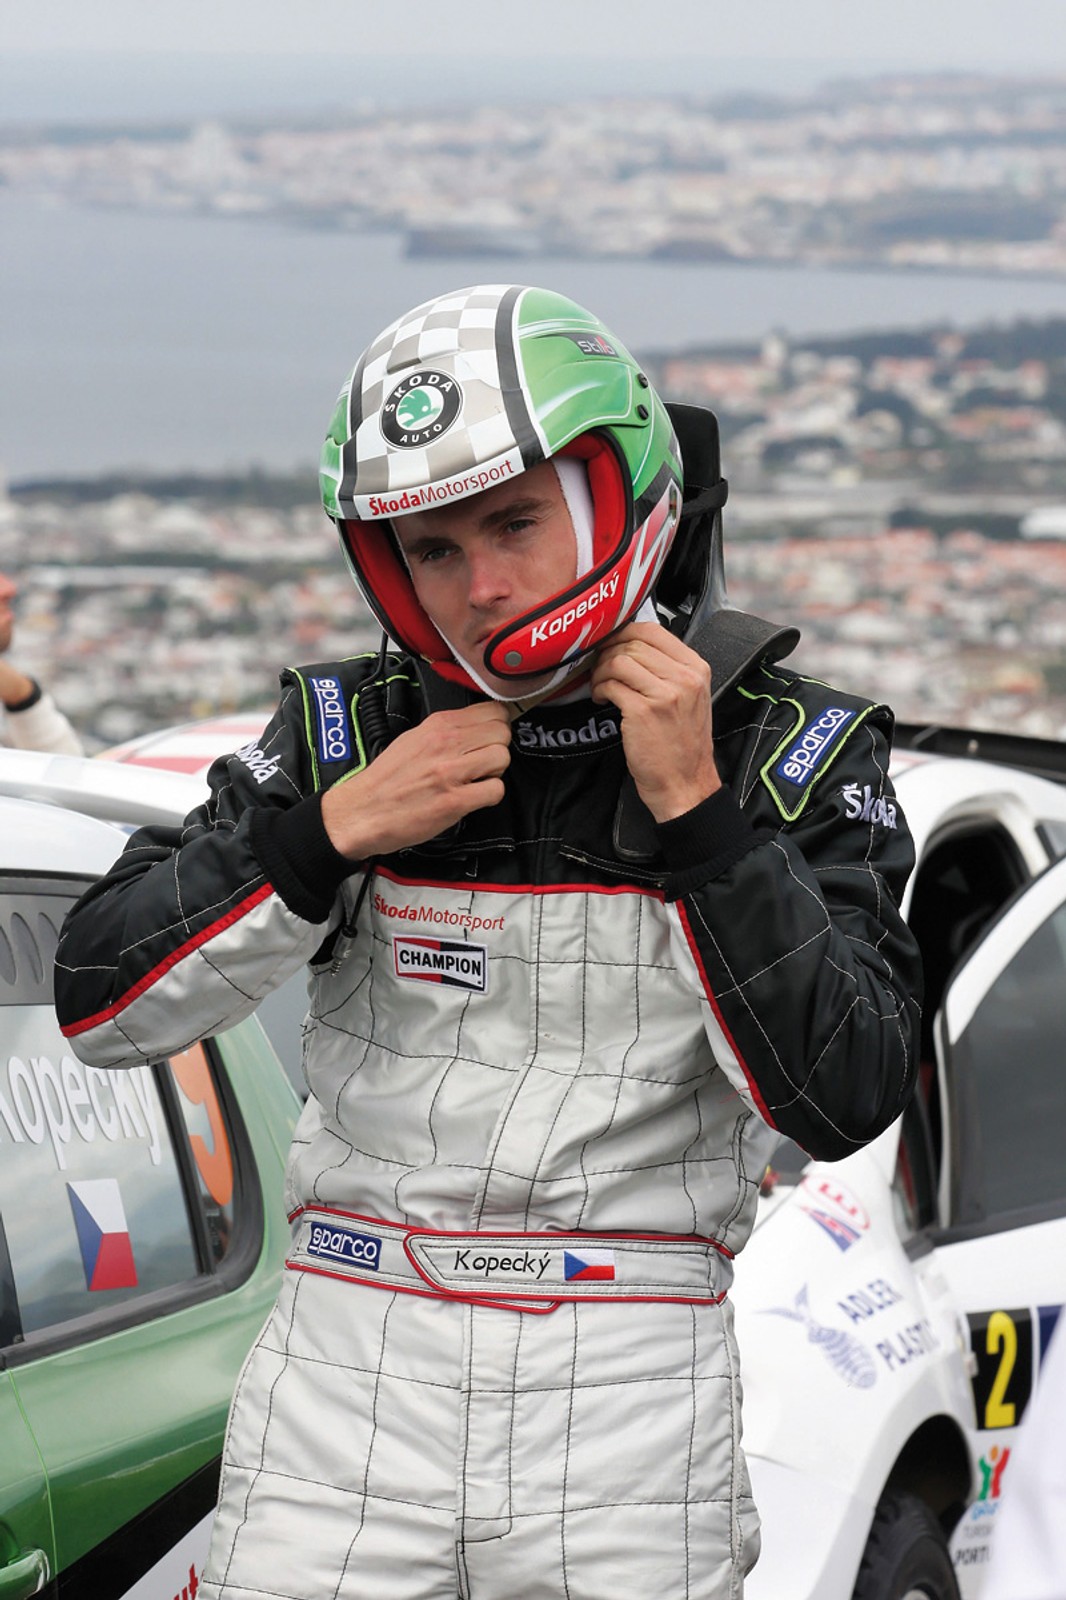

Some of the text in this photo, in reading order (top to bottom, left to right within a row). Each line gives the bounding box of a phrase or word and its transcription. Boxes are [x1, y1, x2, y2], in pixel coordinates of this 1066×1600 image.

[400, 423, 443, 443] AUTO
[531, 571, 620, 647] Kopecký
[314, 678, 347, 759] sparco
[517, 717, 619, 748] Škoda
[783, 708, 851, 783] sparco
[842, 782, 897, 829] Škoda
[399, 949, 481, 976] CHAMPION
[309, 1226, 377, 1267] sparco
[454, 1250, 551, 1280] Kopecký
[984, 1310, 1018, 1429] 2
